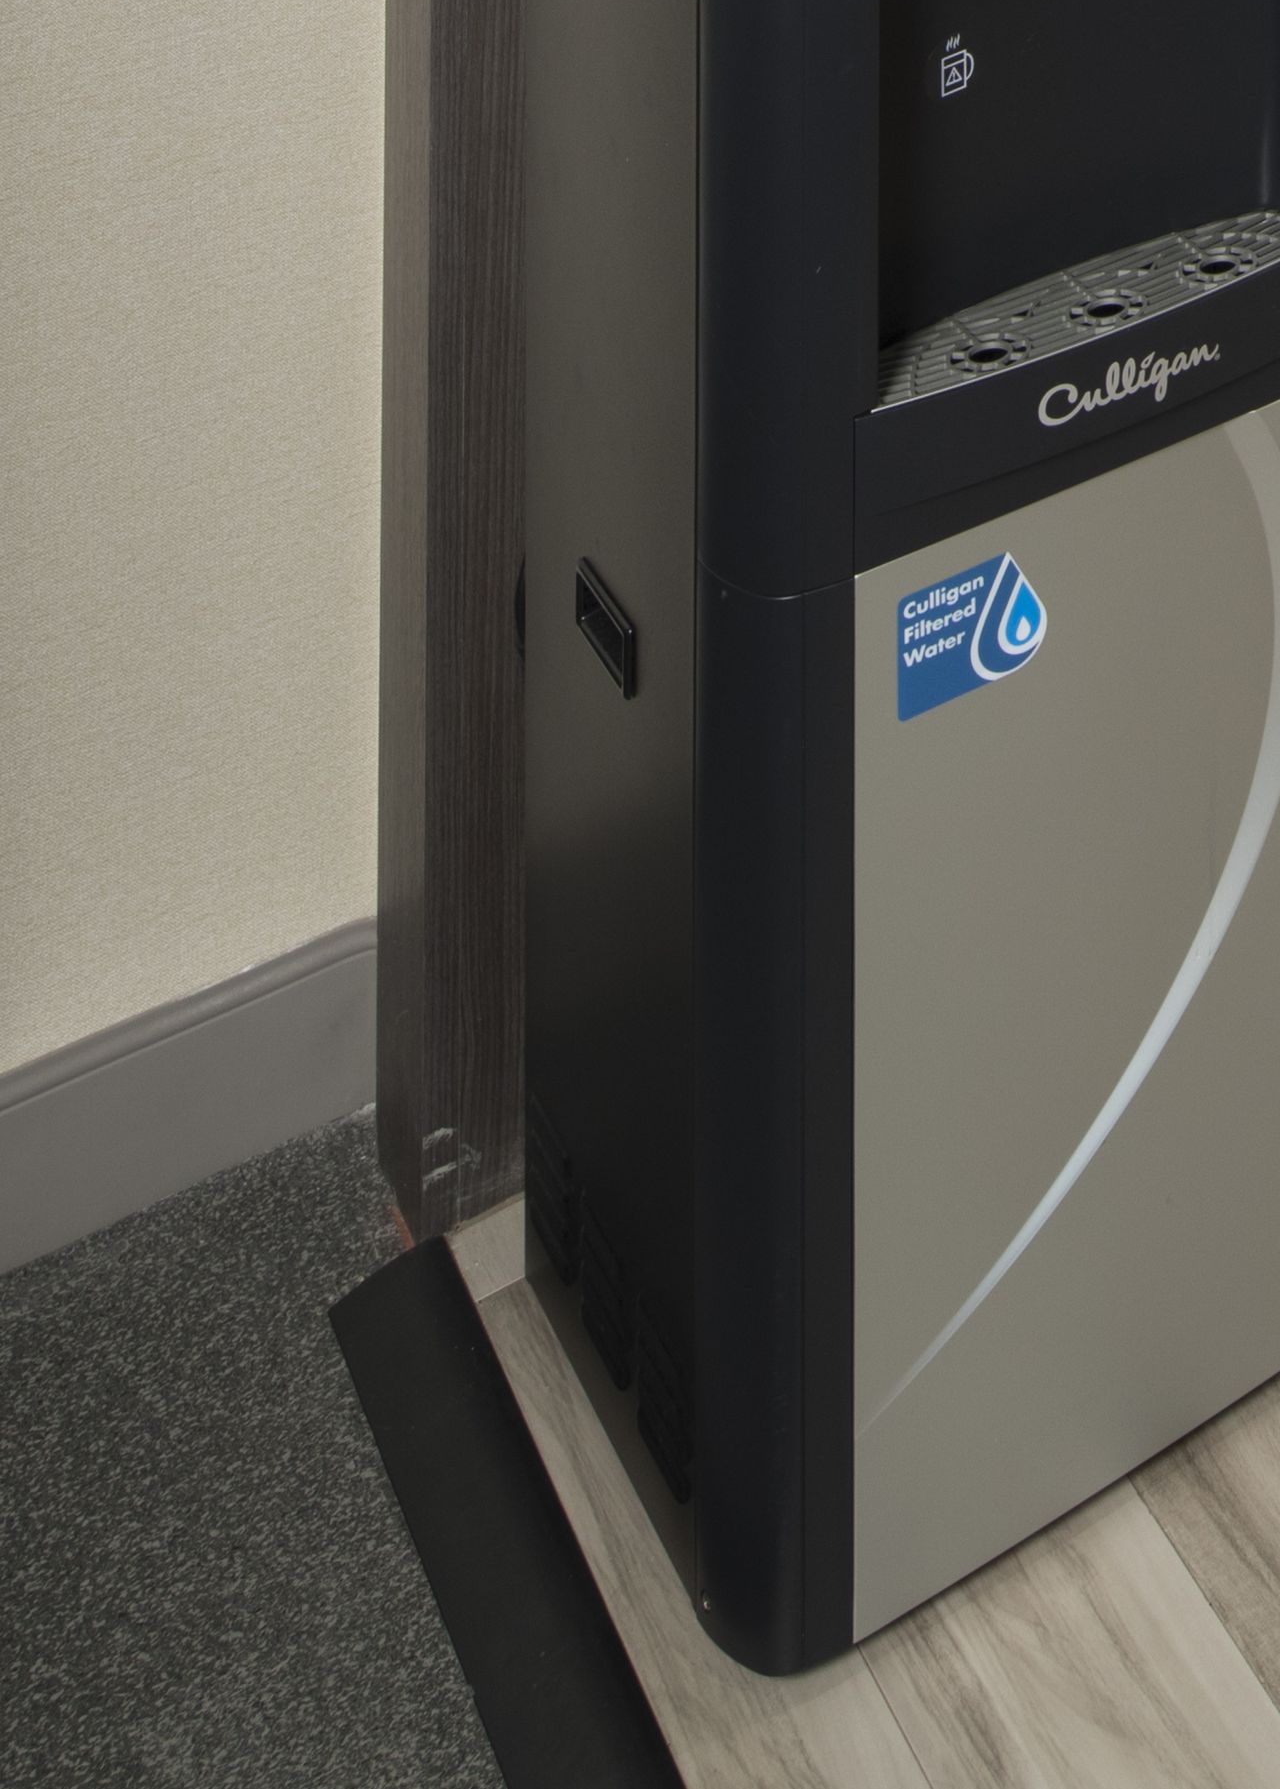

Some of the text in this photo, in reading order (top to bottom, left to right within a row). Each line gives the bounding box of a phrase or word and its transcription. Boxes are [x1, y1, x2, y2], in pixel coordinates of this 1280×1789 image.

[1038, 344, 1219, 426] Culligan
[903, 575, 984, 619] Culligan
[903, 597, 976, 645] Filtered
[903, 631, 965, 667] Water
